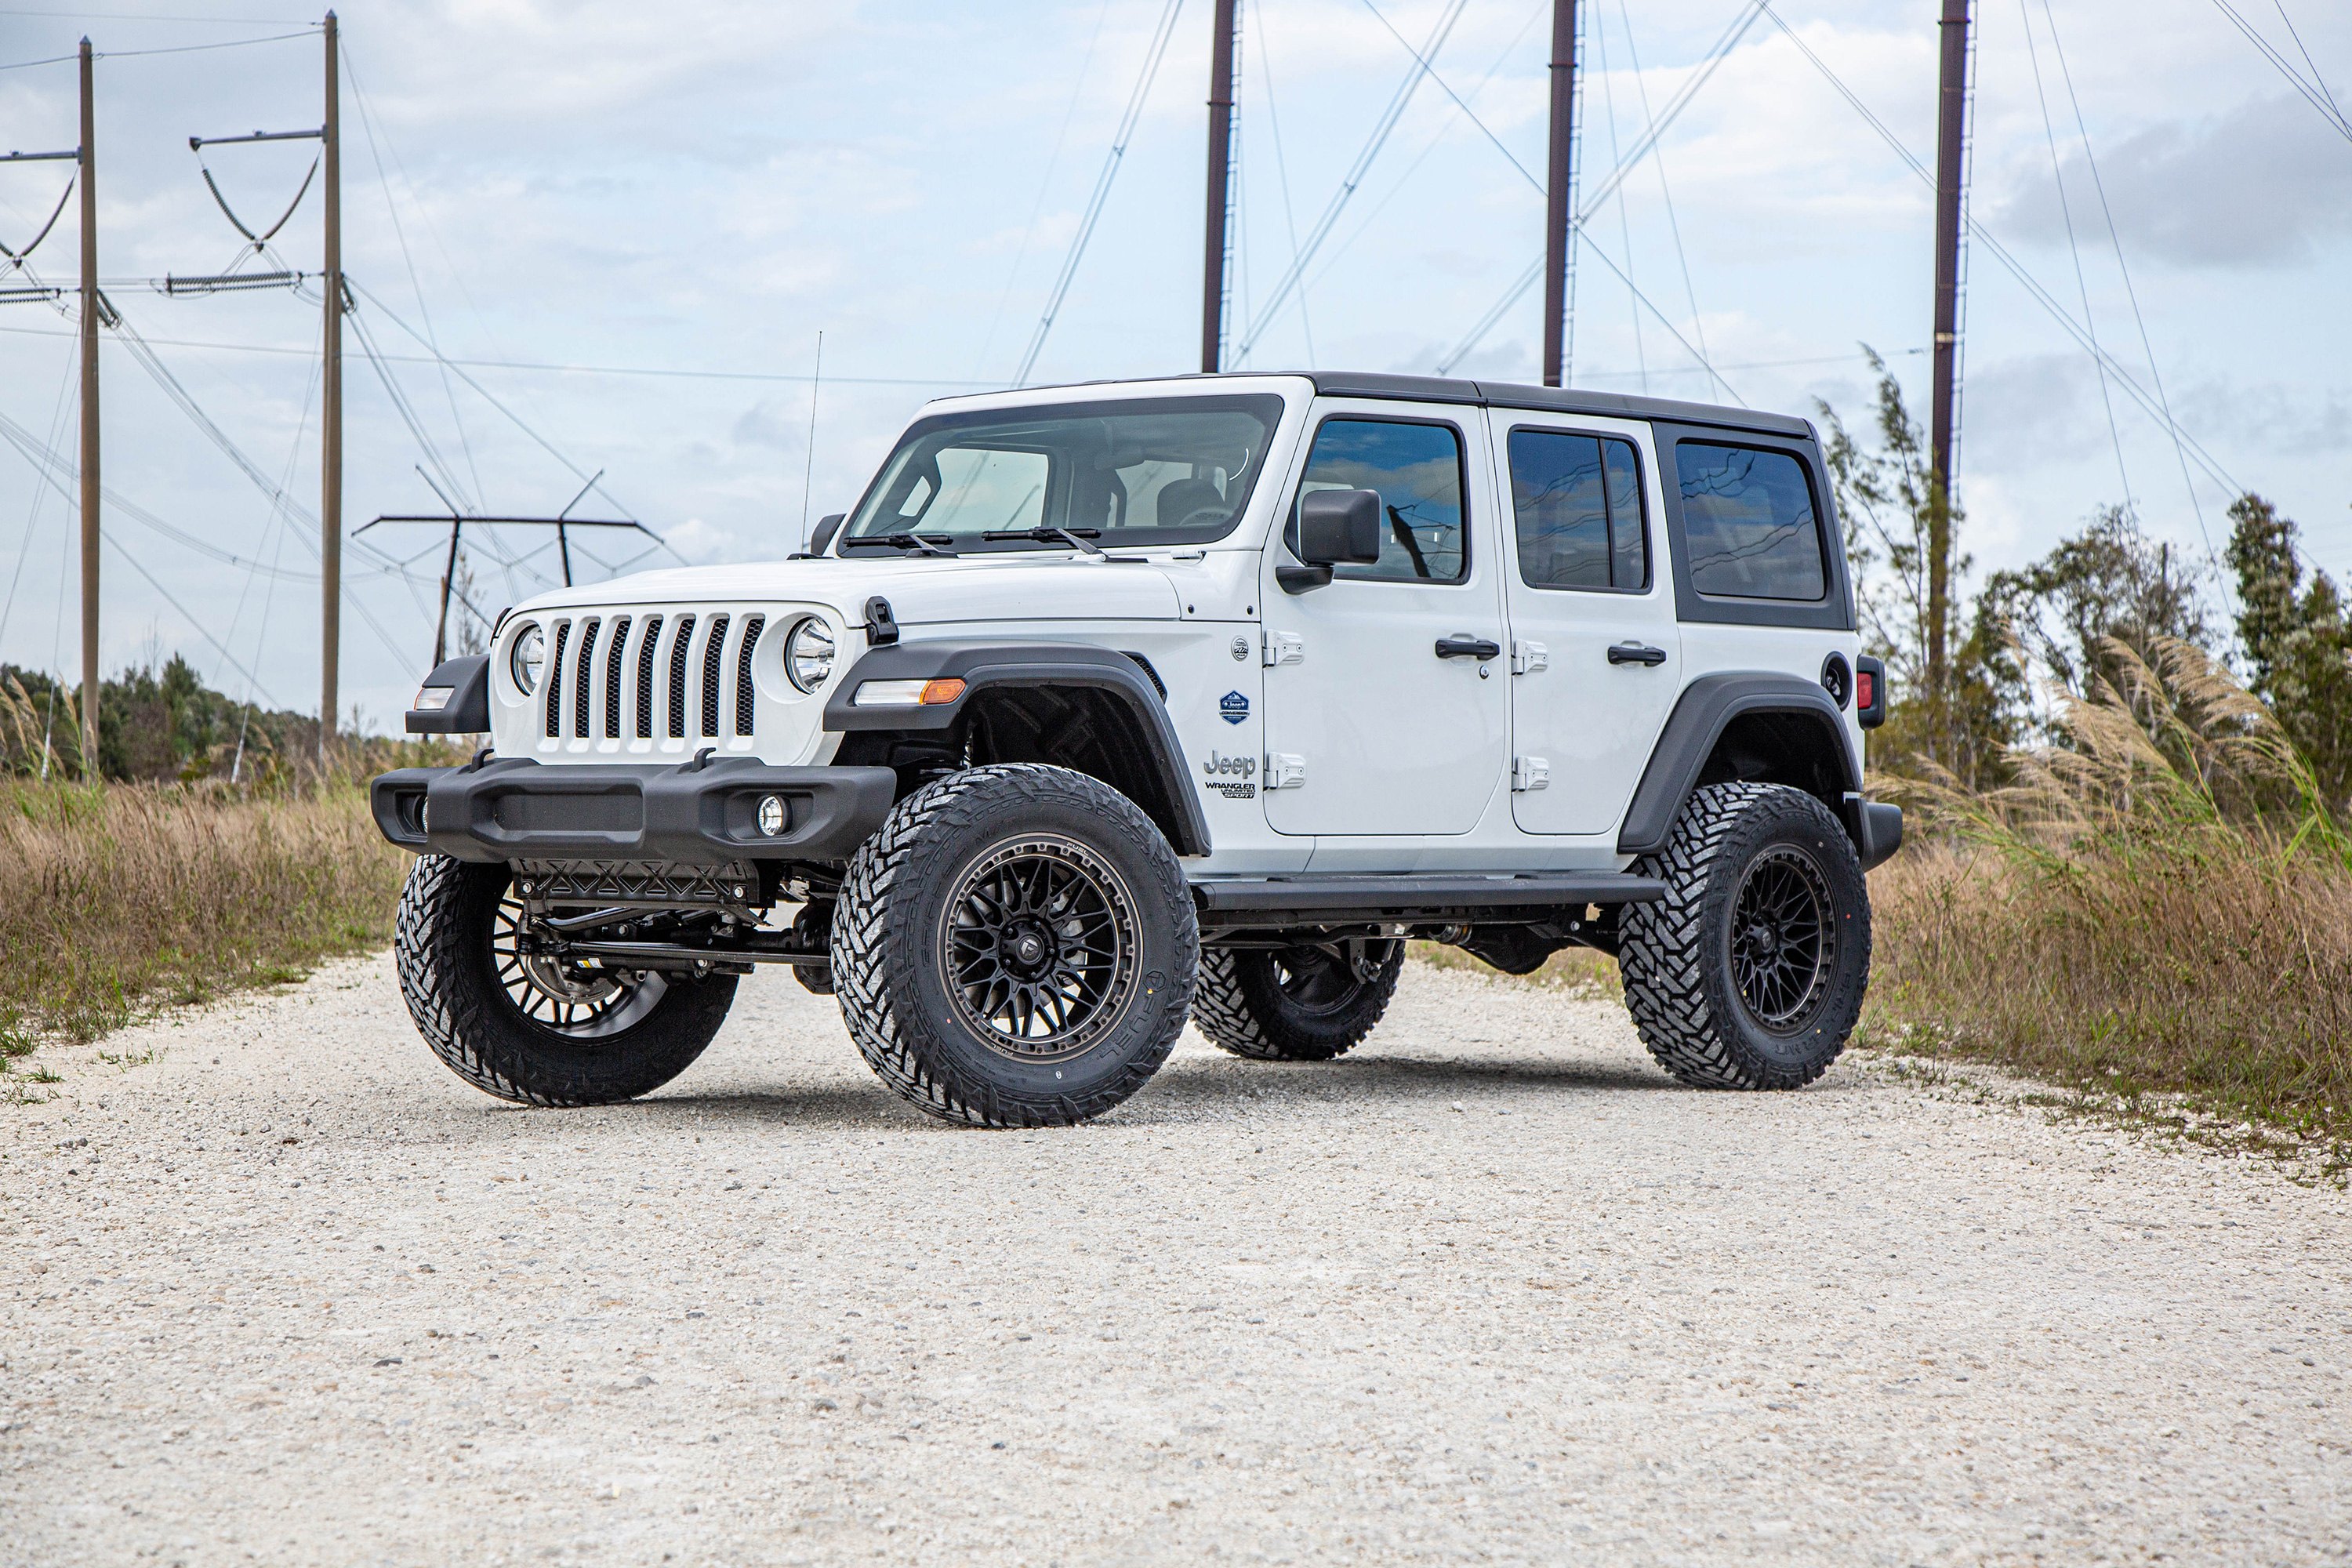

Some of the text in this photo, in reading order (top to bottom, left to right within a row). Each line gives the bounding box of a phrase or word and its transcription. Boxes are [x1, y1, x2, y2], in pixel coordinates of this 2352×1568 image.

[1203, 750, 1256, 780] Jeep
[1066, 841, 1089, 857] FUEL
[990, 1042, 1014, 1057] FUEL
